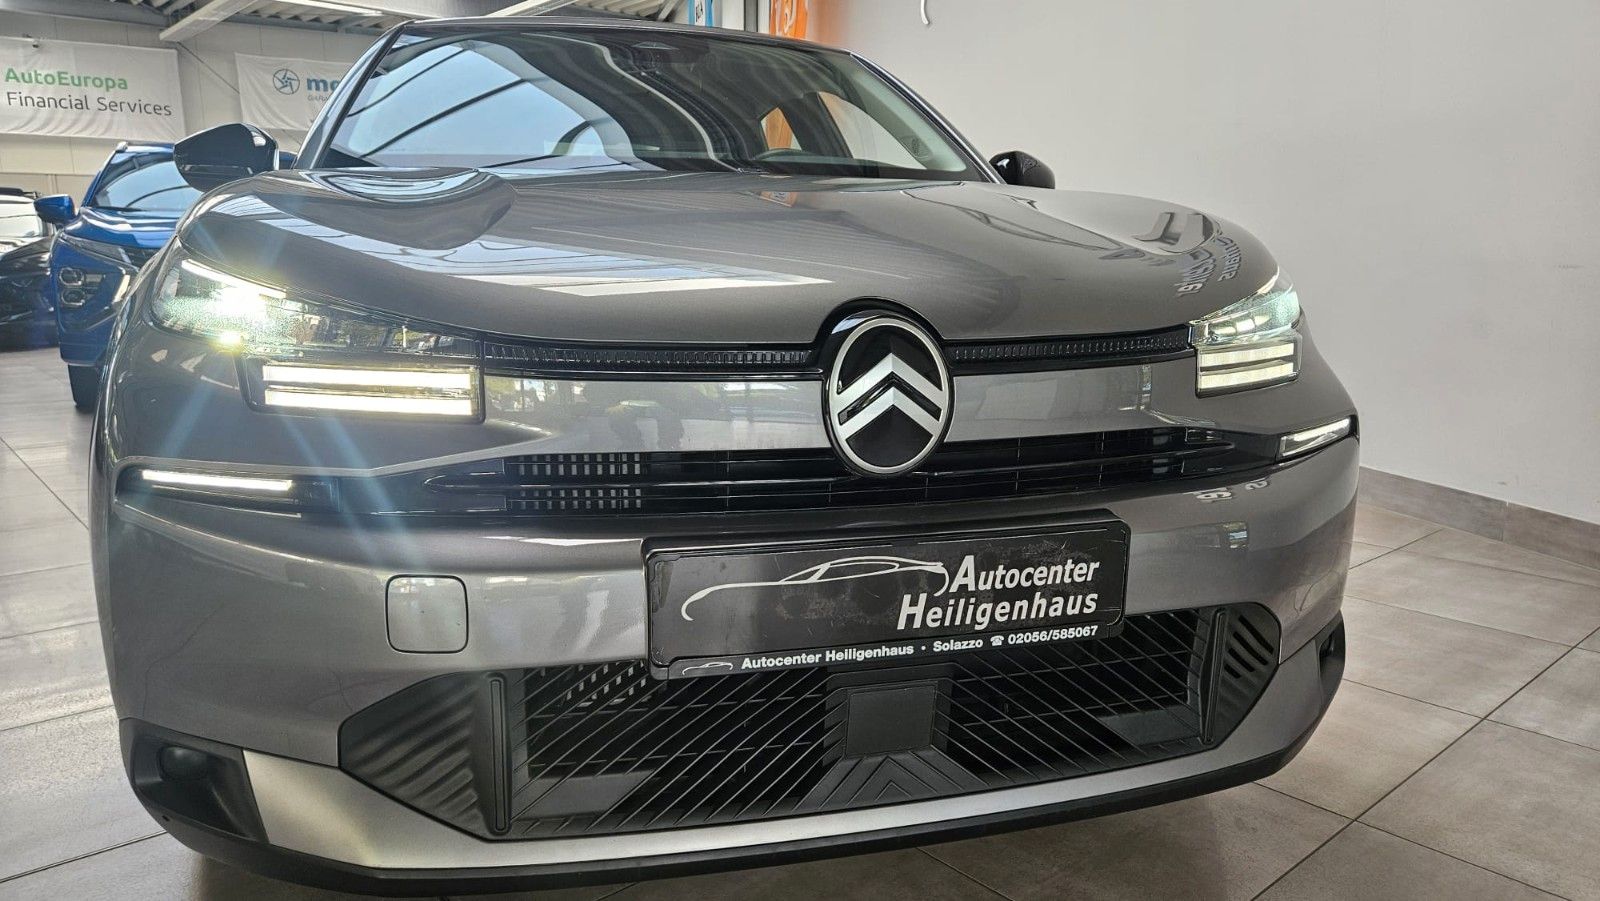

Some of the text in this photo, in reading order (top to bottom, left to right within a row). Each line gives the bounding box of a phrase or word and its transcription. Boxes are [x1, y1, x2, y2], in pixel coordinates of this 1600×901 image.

[4, 67, 128, 91] AutoEuropa
[7, 92, 172, 116] Financial Services
[950, 555, 1099, 594] Autocenter
[897, 593, 1098, 630] Heiligenhaus
[741, 626, 1098, 670] Autocenter Heiligenhaus Solazzo 02056/585067
